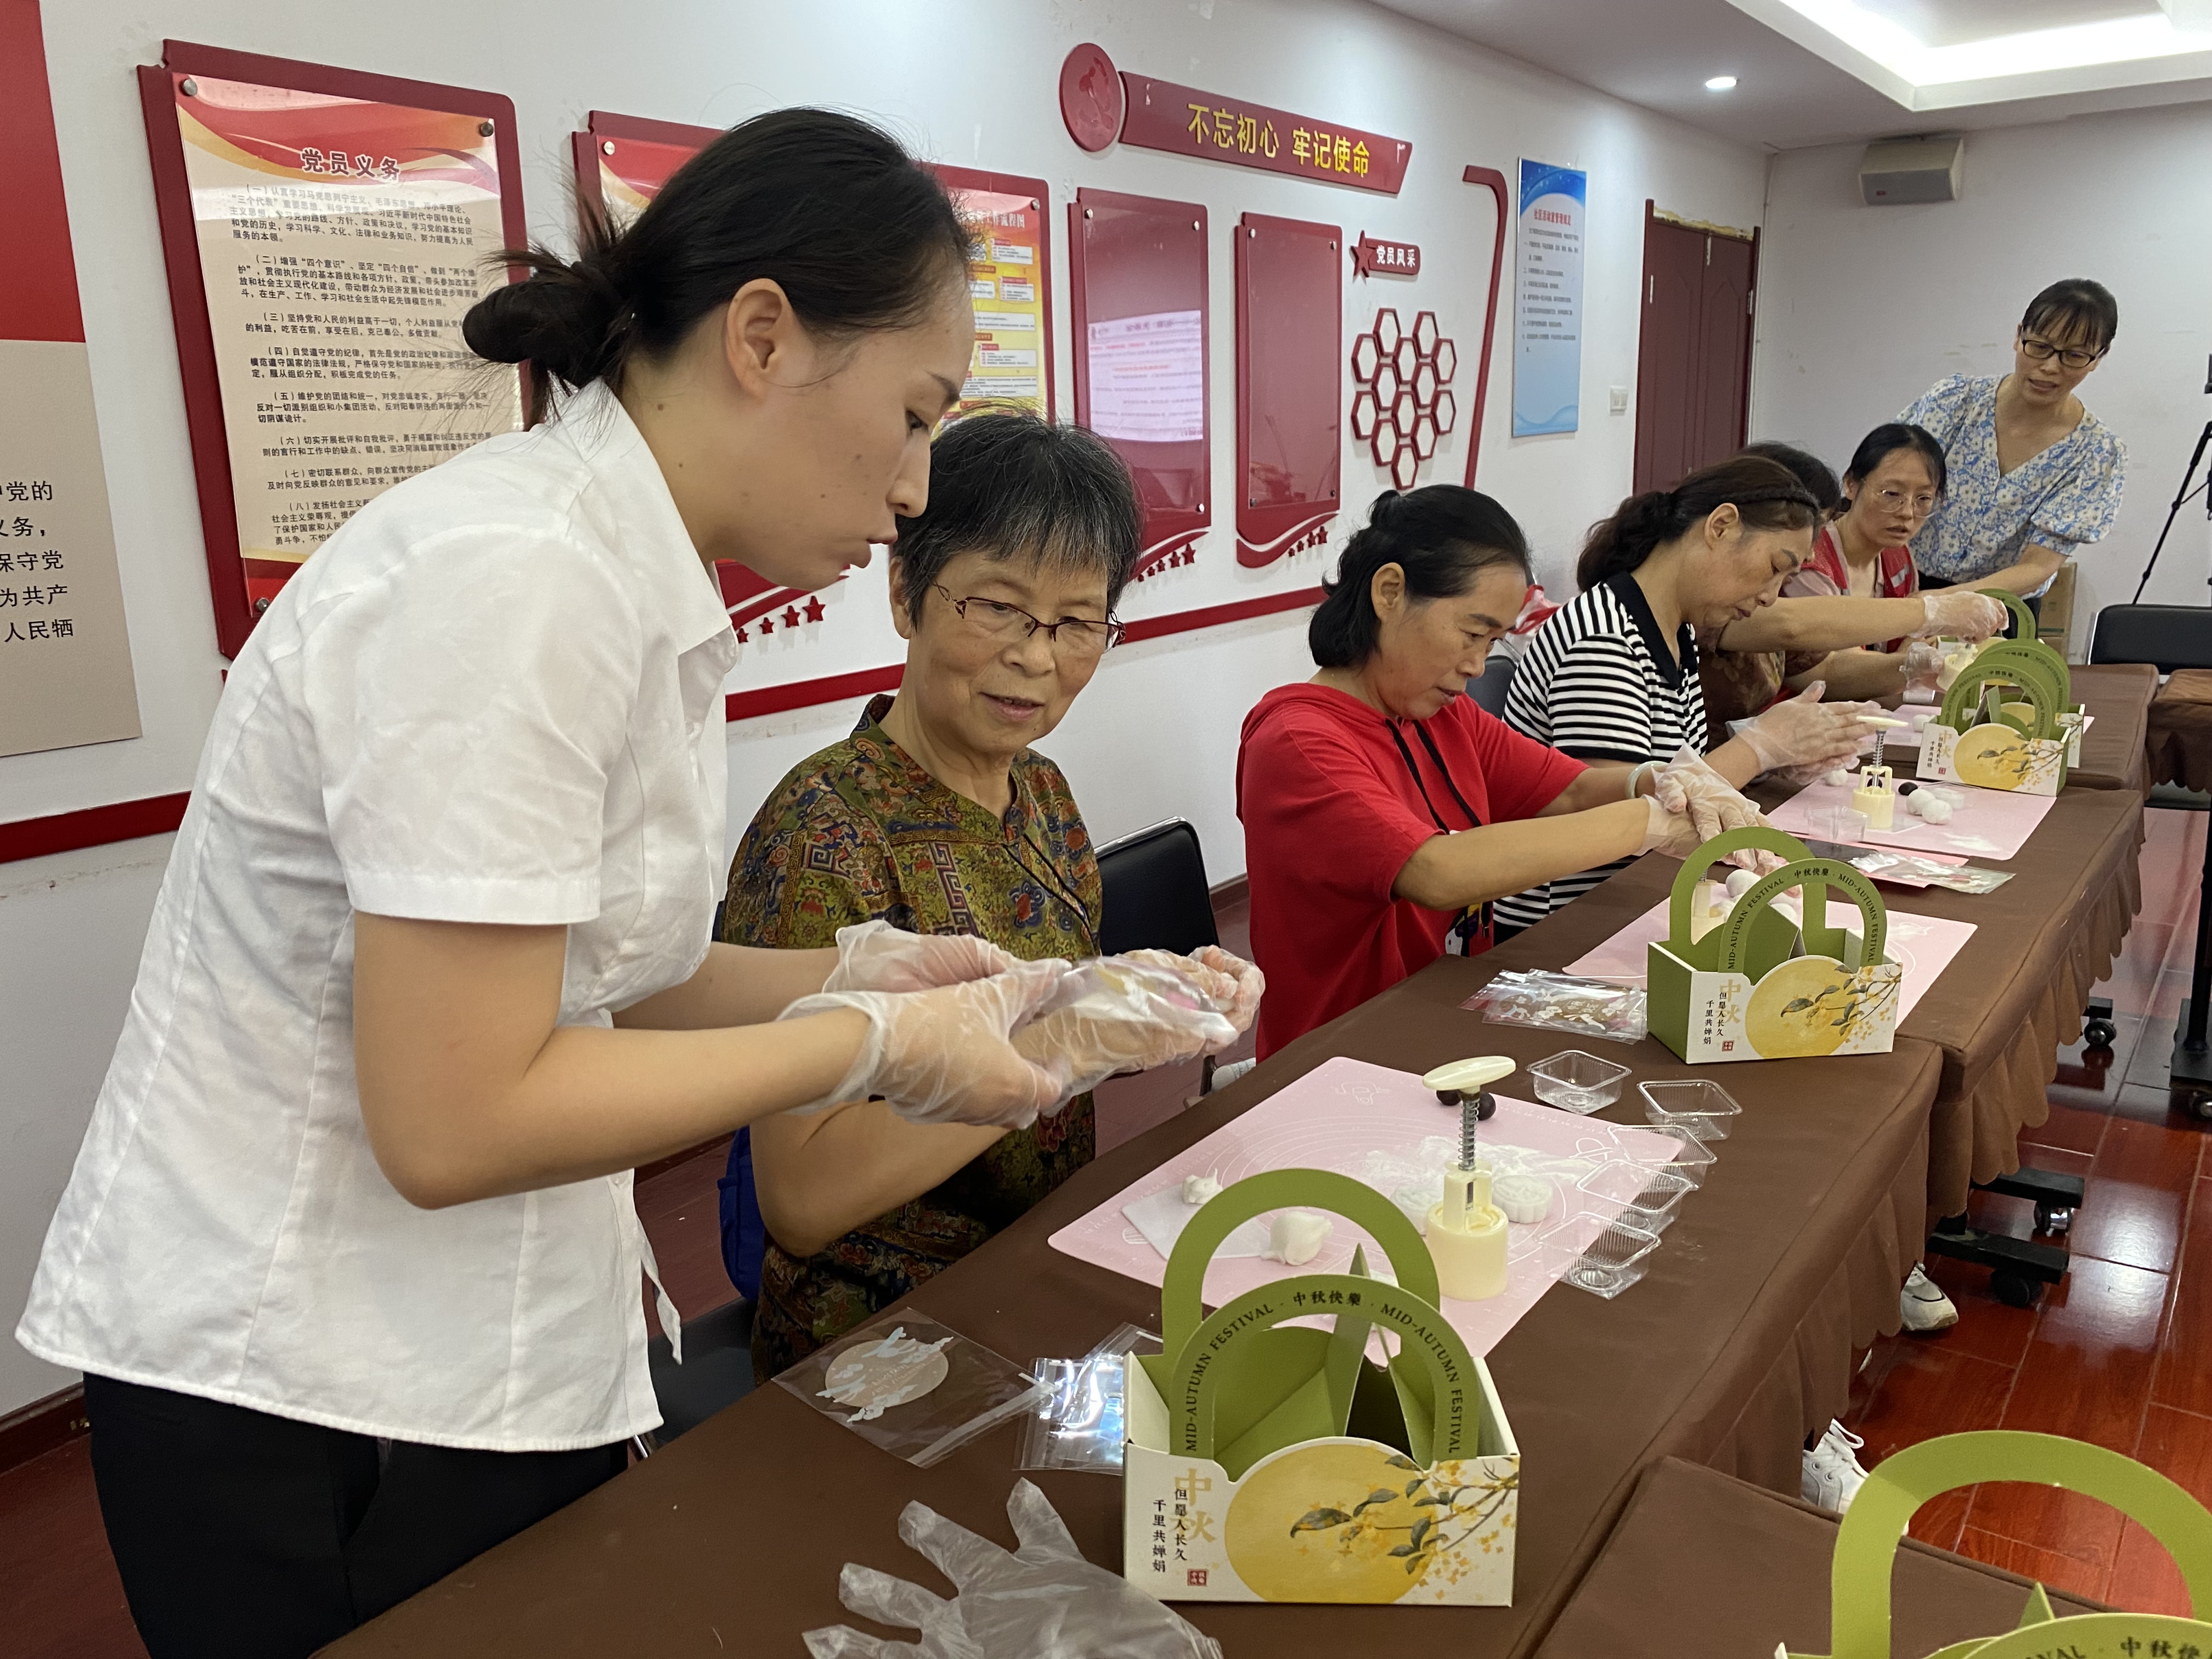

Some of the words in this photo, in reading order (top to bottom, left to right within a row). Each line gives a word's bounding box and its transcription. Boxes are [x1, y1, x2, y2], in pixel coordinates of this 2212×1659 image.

[302, 148, 400, 181] 党员义务
[1186, 103, 1280, 159] 不忘初心
[1292, 127, 1370, 178] 牢记使命
[1376, 245, 1416, 268] 党员风采
[4, 619, 74, 642] 人民牺
[1728, 910, 1748, 969] MID-AUTUMN
[1747, 878, 1784, 909] FESTIVAL
[1838, 873, 1878, 921] MID-AUTUMN
[1867, 923, 1879, 962] FESTIVAL
[1186, 1352, 1212, 1452] MID-AUTUMN
[1209, 1304, 1274, 1351] FESTIVAL
[1380, 1303, 1460, 1384] MID-AUTUMN
[1448, 1389, 1463, 1453] FESTIVAL
[1152, 1499, 1167, 1573] 千里共婵娟
